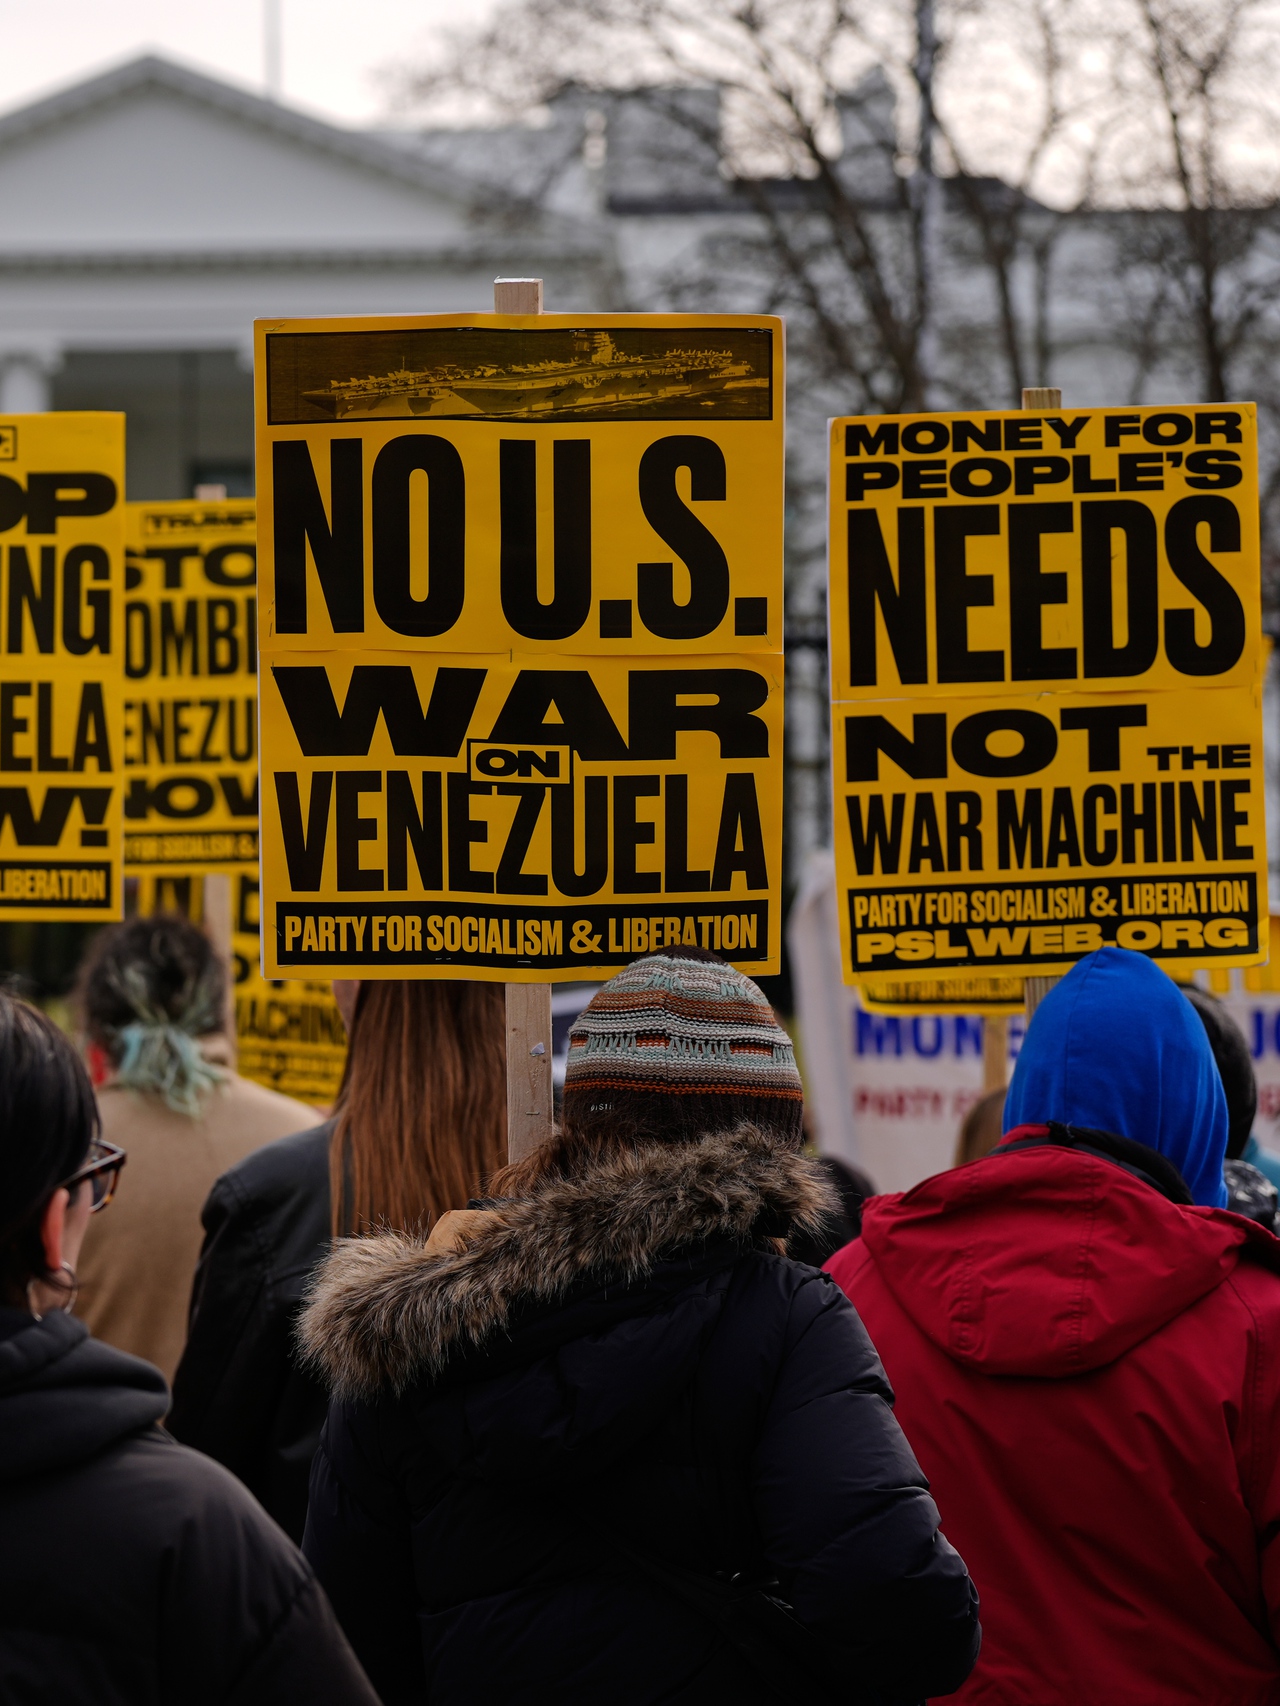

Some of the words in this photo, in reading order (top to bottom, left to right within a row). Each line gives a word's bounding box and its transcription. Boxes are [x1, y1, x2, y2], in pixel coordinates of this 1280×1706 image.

[845, 416, 1091, 457] MONEY
[1104, 411, 1243, 448] FOR
[845, 450, 1243, 502] PEOPLE'S
[272, 434, 466, 638] NO
[499, 435, 768, 640] U.S.
[847, 495, 1246, 687] NEEDS
[272, 666, 771, 761] WAR
[845, 704, 1148, 782] NOT
[1148, 744, 1252, 771] THE
[475, 748, 560, 778] ON
[273, 771, 769, 896] VENEZUELA
[845, 790, 984, 876] WAR
[996, 779, 1255, 871] MACHINE
[285, 915, 367, 951] PARTY
[372, 915, 422, 952] FOR
[426, 915, 563, 956] SOCIALISM
[569, 919, 603, 954] &
[608, 914, 757, 953] LIBERATION
[854, 893, 922, 928] PARTY
[924, 891, 968, 925] FOR
[970, 886, 1085, 923] SOCIALISM
[1089, 886, 1118, 917] &
[1121, 880, 1249, 916] LIBERATION
[856, 918, 1250, 963] PSLWEB.ORG
